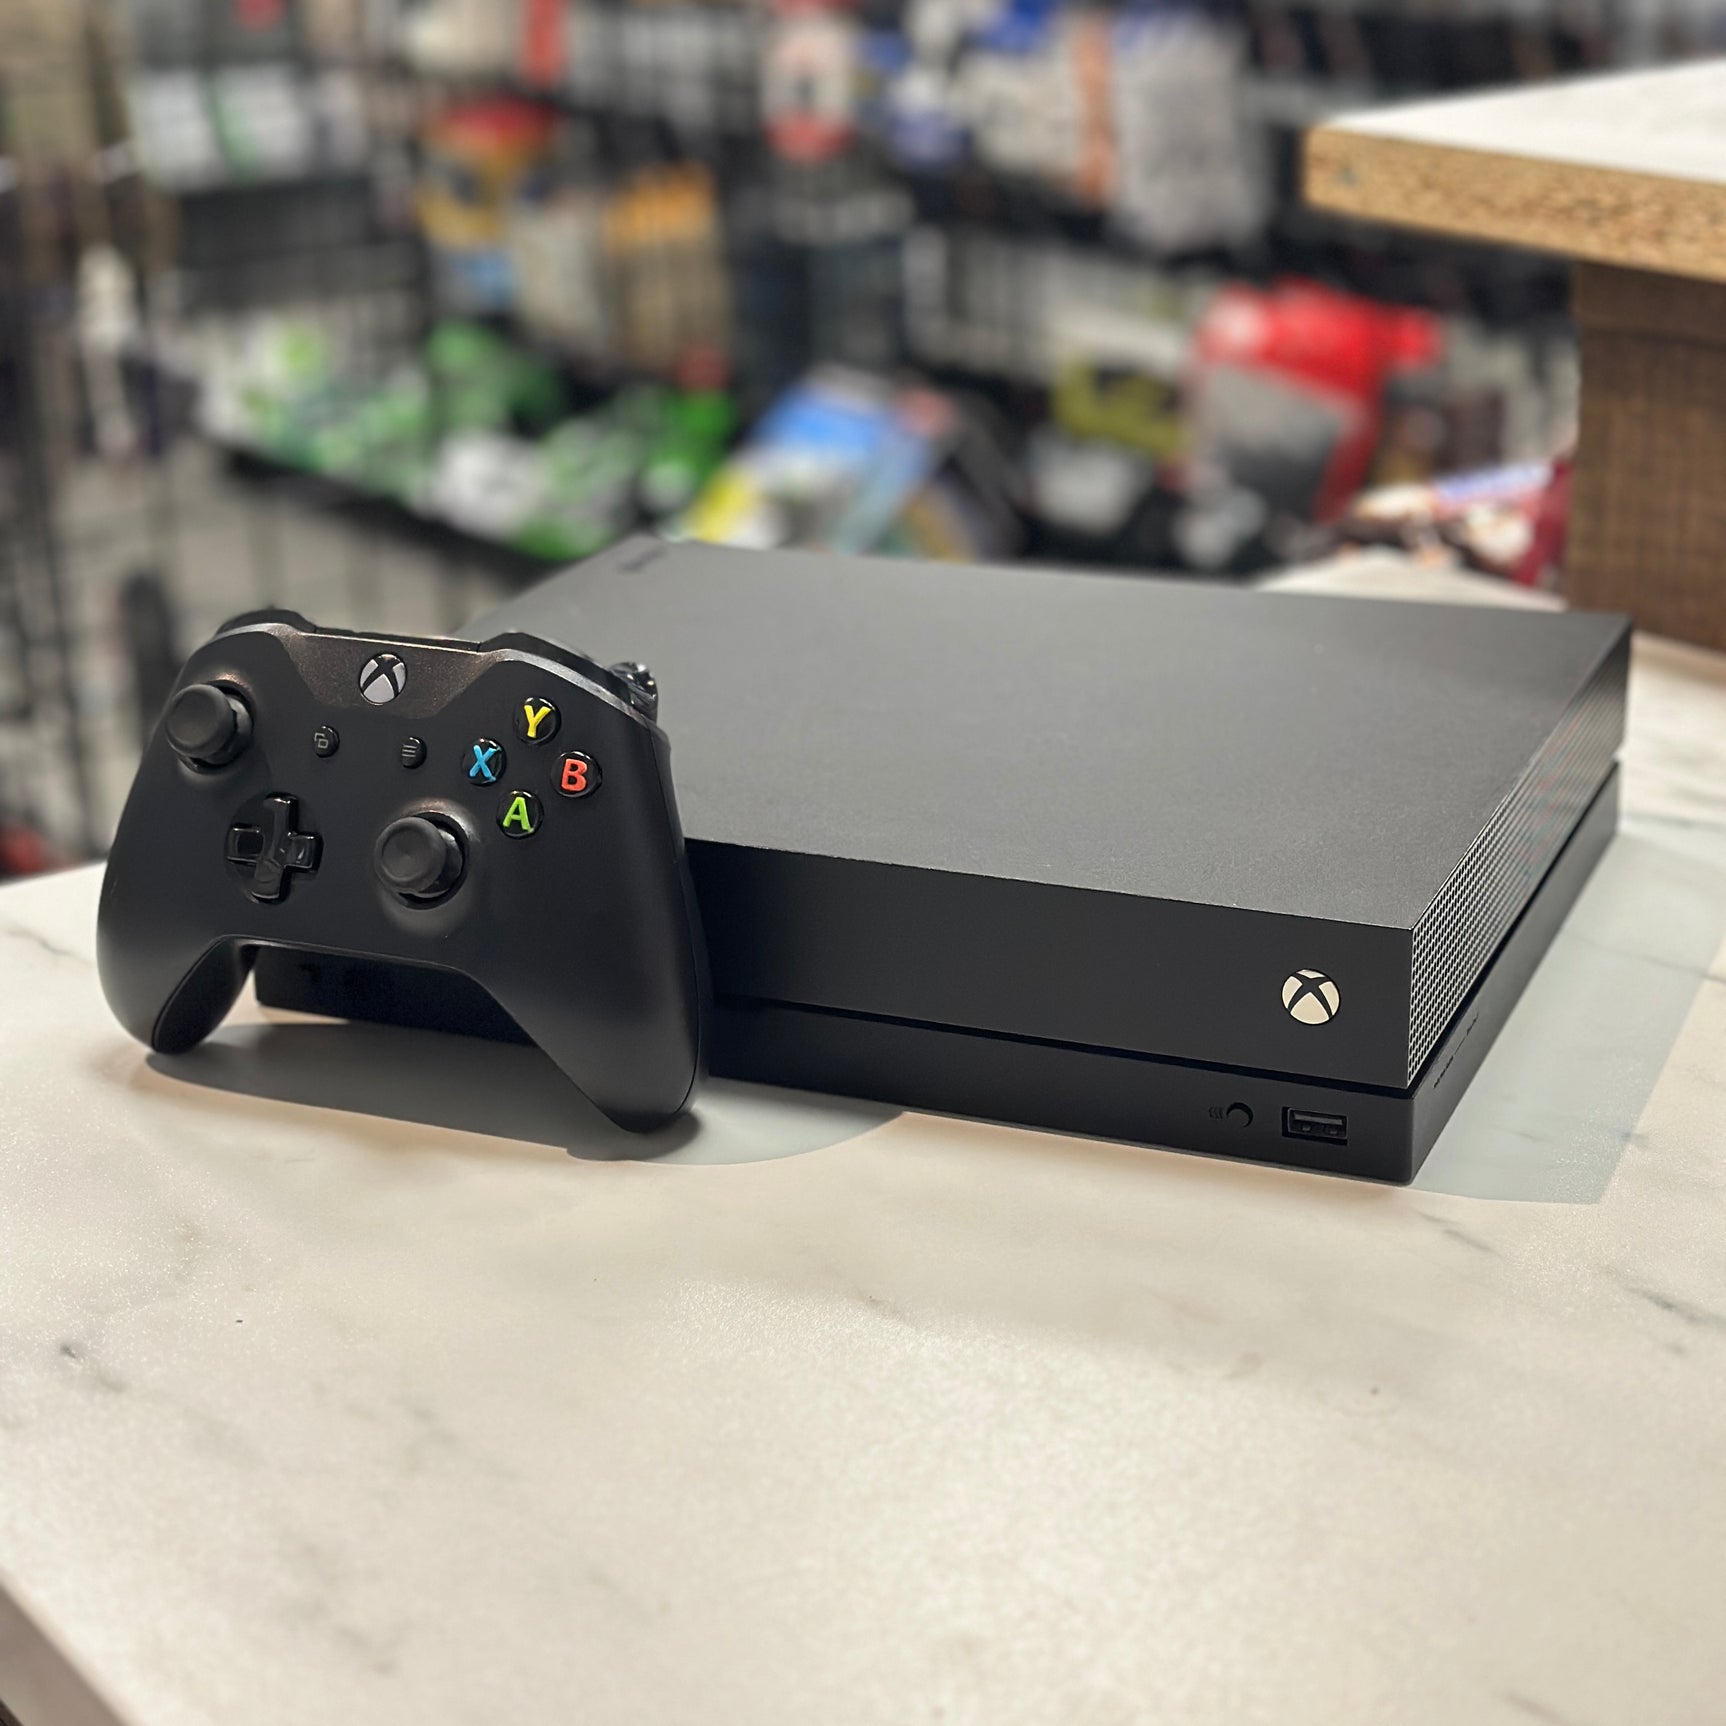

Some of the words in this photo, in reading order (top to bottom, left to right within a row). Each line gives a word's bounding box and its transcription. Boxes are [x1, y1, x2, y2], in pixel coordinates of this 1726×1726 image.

[523, 704, 552, 738] Y
[469, 744, 498, 782] X
[560, 758, 588, 792] B
[502, 796, 533, 833] A
